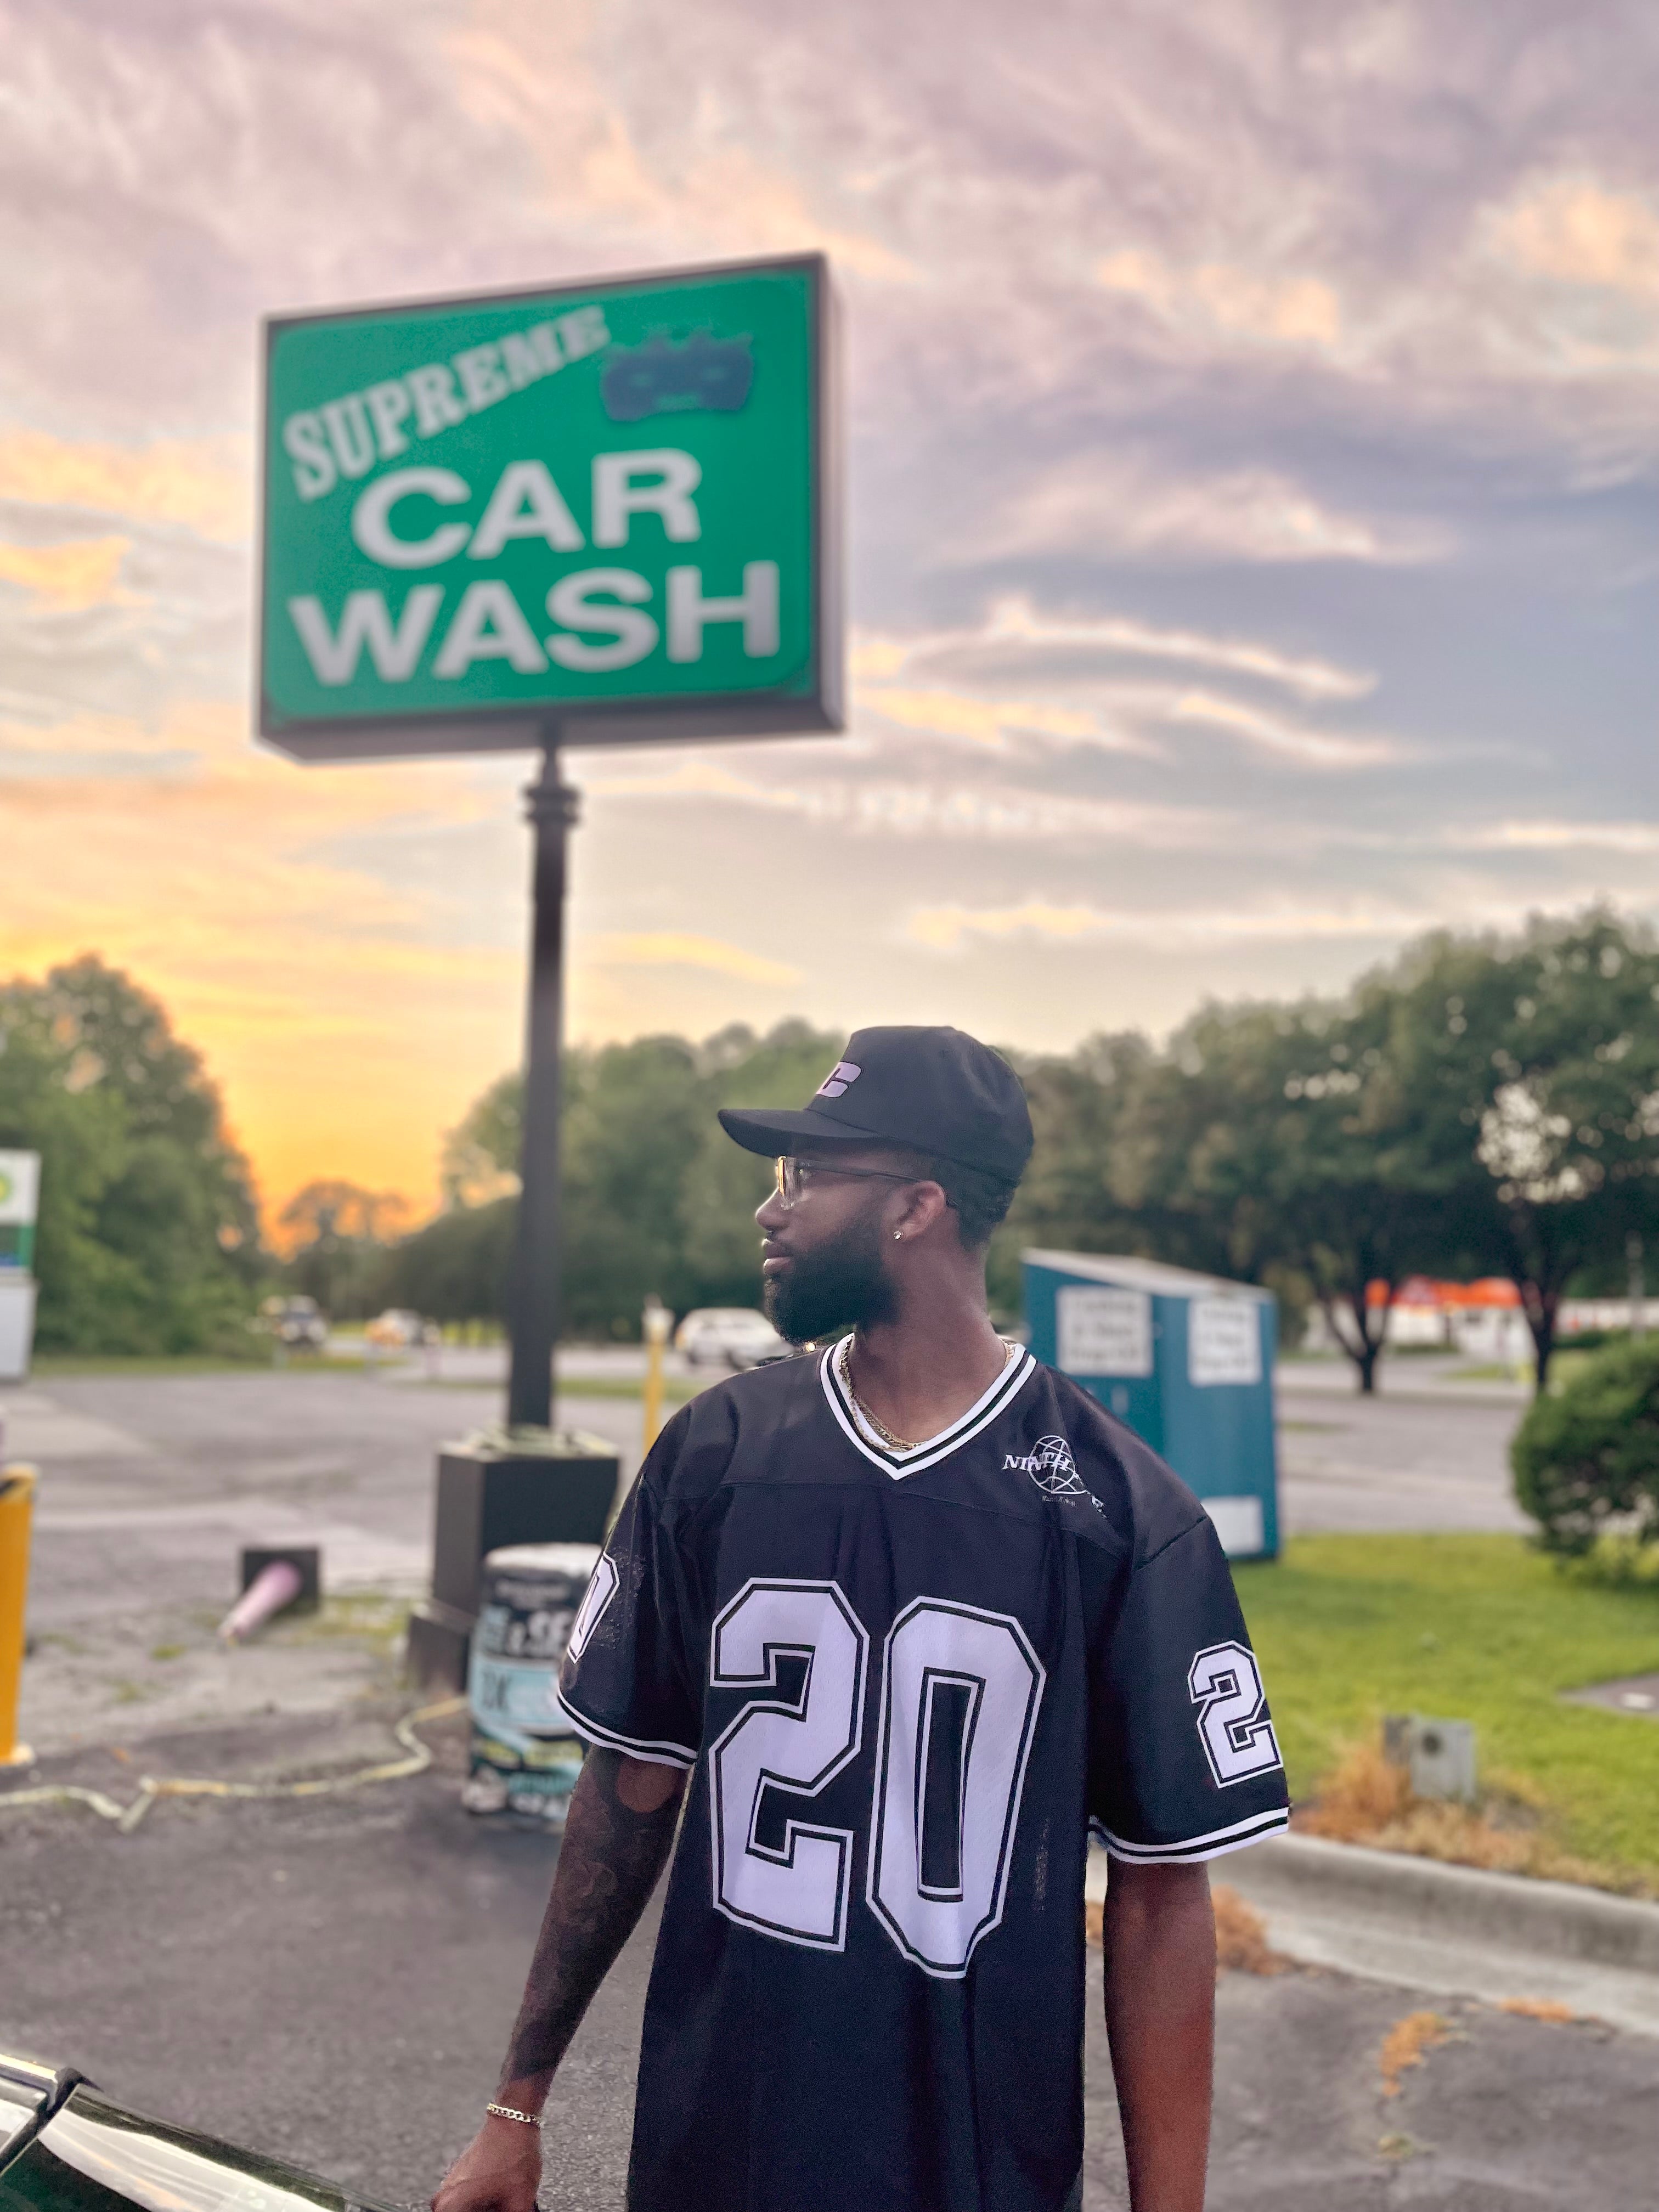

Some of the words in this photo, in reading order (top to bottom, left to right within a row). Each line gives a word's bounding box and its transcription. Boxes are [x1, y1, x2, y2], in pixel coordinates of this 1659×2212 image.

[285, 306, 610, 500] SUPREME
[353, 448, 701, 568] CAR
[287, 560, 781, 687] WASH
[709, 1577, 1046, 1979] 20
[1187, 1640, 1284, 1788] 2
